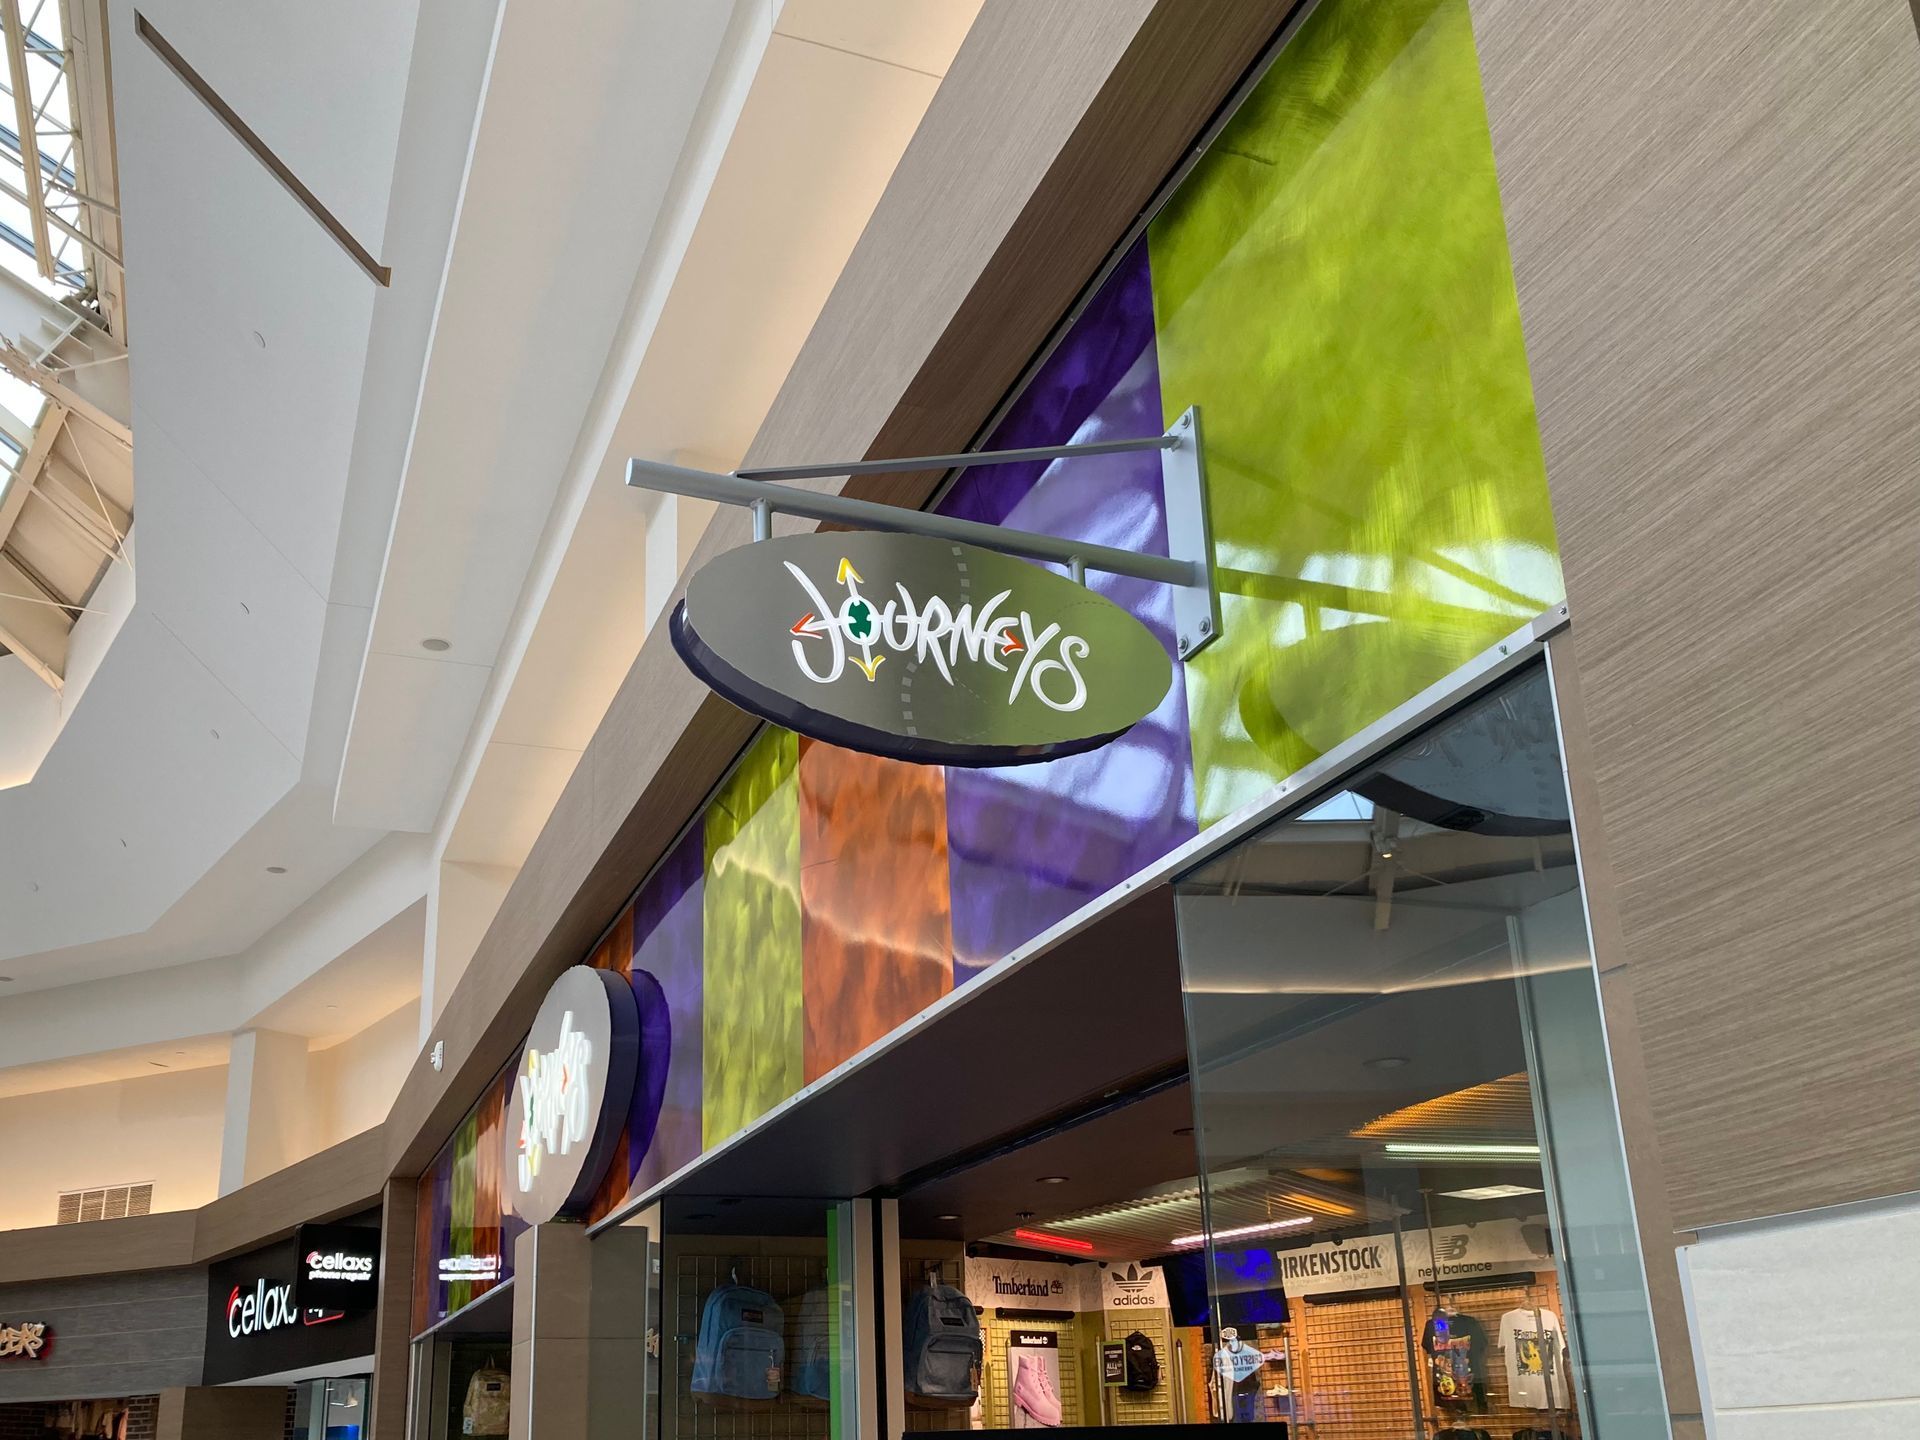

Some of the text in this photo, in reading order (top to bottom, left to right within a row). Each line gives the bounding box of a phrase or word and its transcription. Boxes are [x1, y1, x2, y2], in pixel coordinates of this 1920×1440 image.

[783, 561, 1090, 712] JOURNEYS
[309, 1252, 372, 1271] cellaxs
[1418, 1262, 1493, 1278] new balance
[308, 1270, 372, 1282] phone repair
[992, 1275, 1049, 1297] Timberland
[1113, 1294, 1155, 1306] adidas
